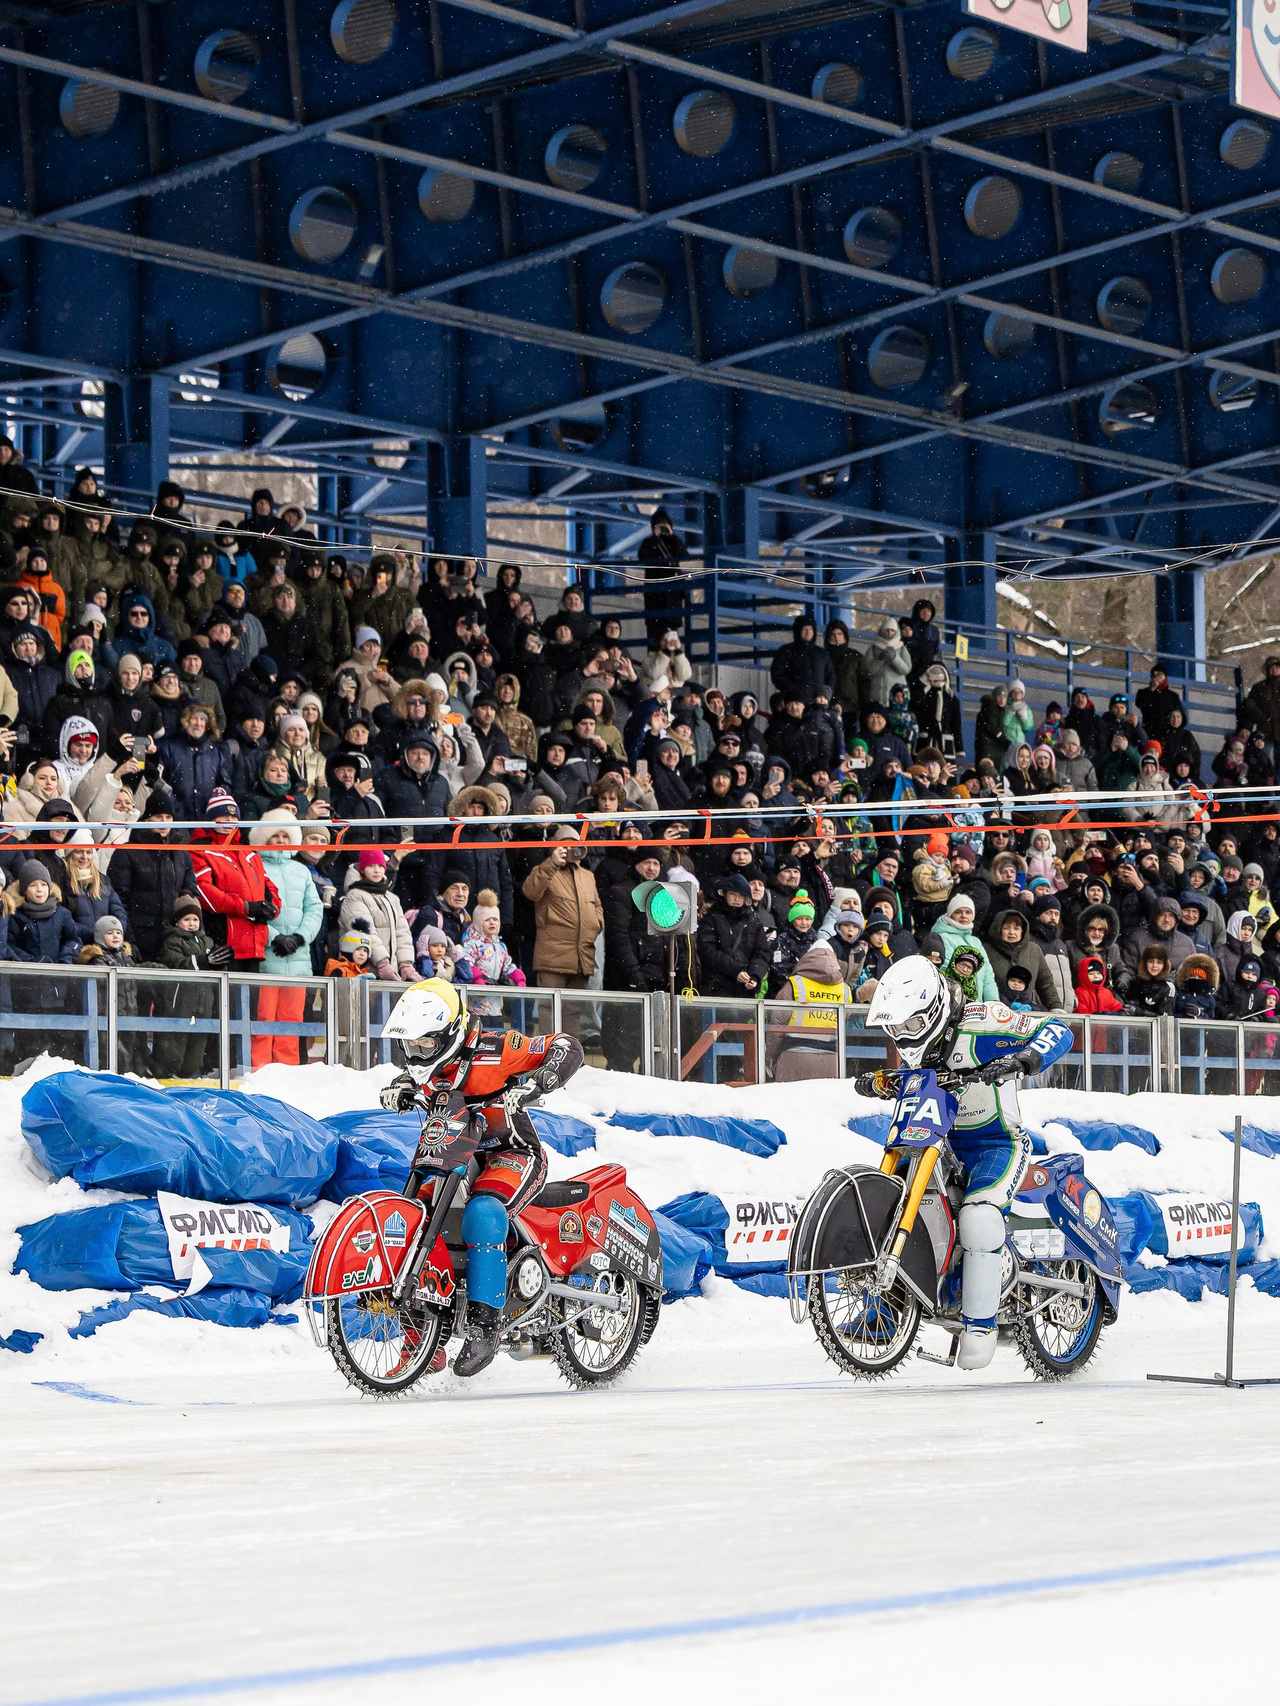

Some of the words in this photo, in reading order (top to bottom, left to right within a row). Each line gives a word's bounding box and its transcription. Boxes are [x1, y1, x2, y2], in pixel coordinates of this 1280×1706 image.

[809, 991, 841, 1002] SAFETY
[1029, 1024, 1067, 1054] UFA
[170, 1209, 272, 1237] ФМСМО
[736, 1201, 800, 1227] ФМСМ
[1169, 1202, 1232, 1226] ФМСМО
[1099, 1217, 1118, 1243] СМК
